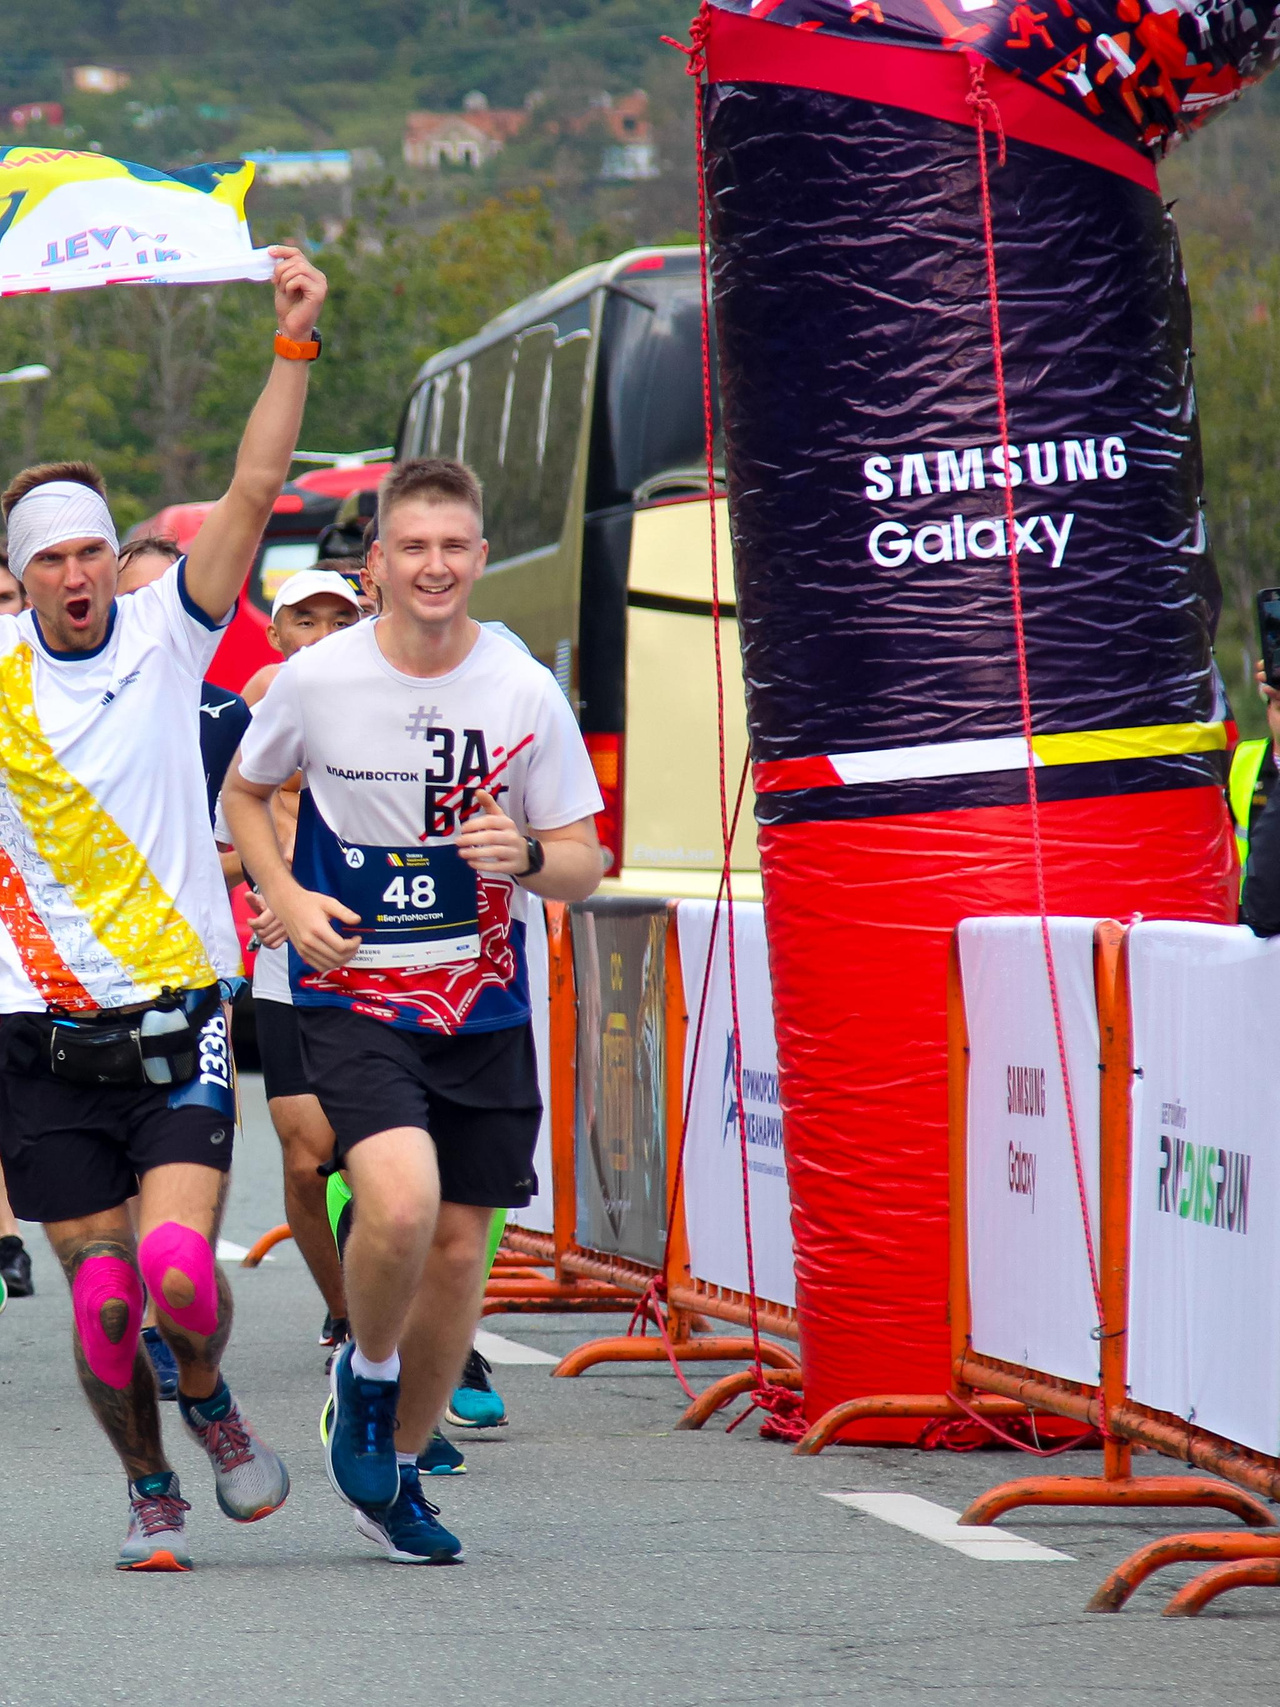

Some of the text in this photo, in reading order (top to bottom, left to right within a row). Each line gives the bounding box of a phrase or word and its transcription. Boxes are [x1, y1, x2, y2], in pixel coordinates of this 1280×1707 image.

[863, 436, 1128, 501] SAMSUNG
[867, 513, 1075, 569] Galaxy
[326, 765, 420, 782] ВЛАДИВОСТОК
[350, 851, 361, 865] A
[382, 874, 437, 910] 48
[376, 912, 444, 924] #БегуПоМостам
[743, 1068, 780, 1105] ПРИМОРСКИ
[1007, 1064, 1046, 1118] SAMSUNG
[745, 1111, 784, 1150] КЕАНАРИУ
[1008, 1140, 1037, 1214] Galaxy
